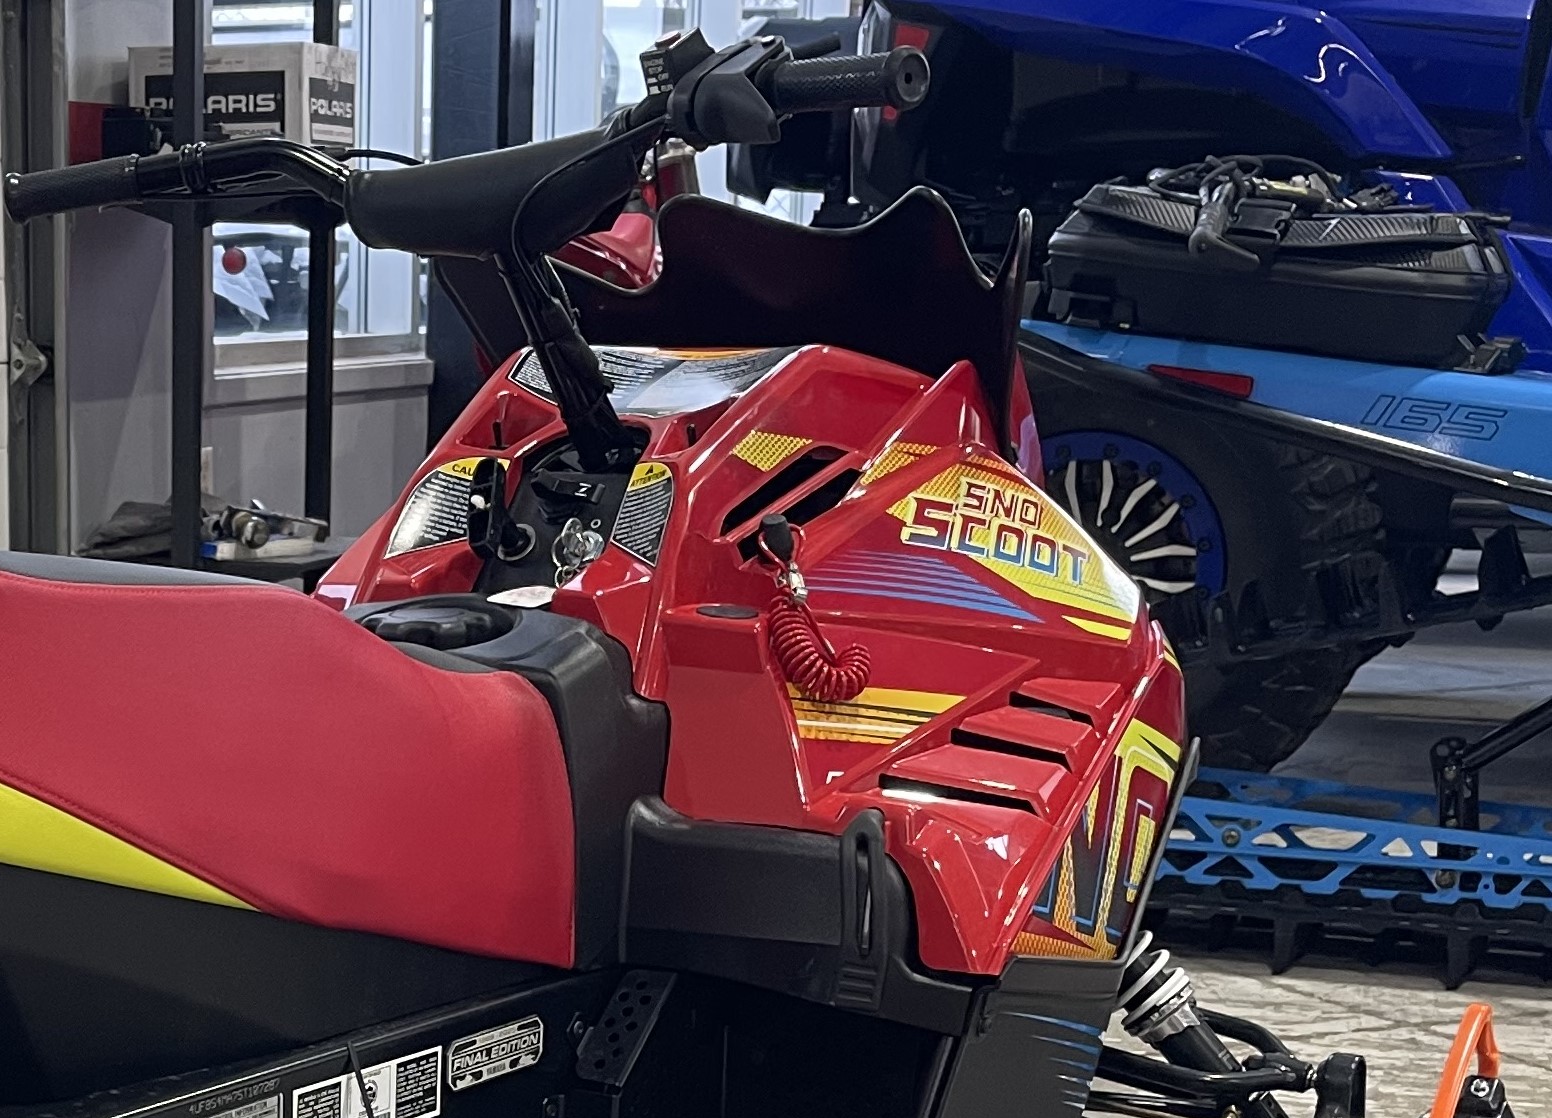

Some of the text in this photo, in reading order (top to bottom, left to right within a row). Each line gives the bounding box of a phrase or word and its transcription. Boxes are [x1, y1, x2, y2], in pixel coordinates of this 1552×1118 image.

[310, 97, 353, 119] POLARIS
[1359, 394, 1509, 442] 165
[958, 478, 1044, 531] SNO
[901, 494, 1089, 586] SCOOT
[452, 1049, 490, 1072] FINAL
[490, 1032, 539, 1059] EDITION
